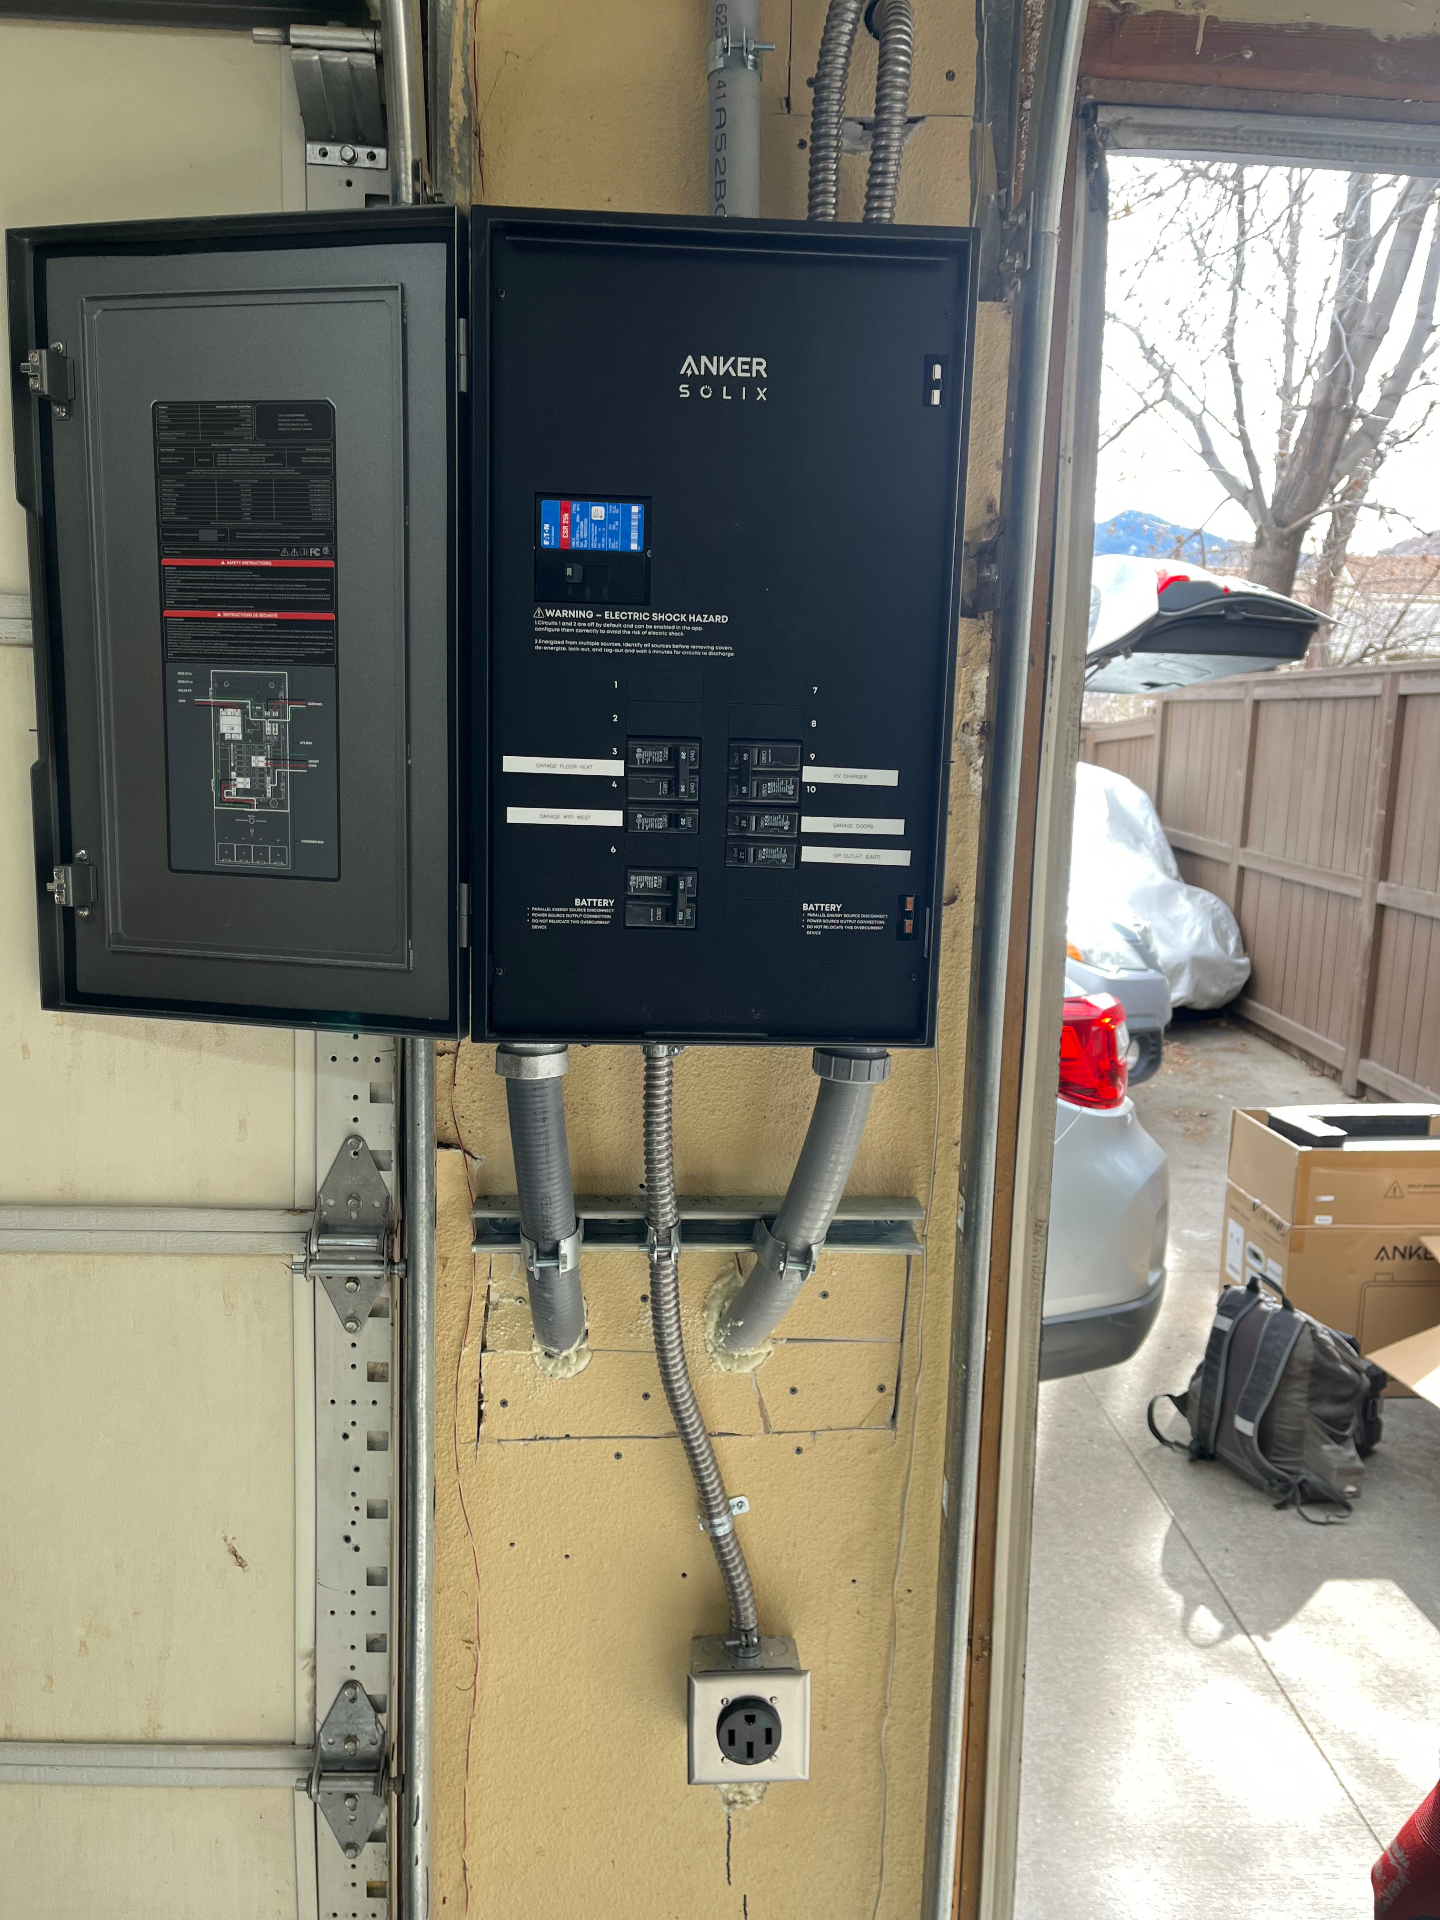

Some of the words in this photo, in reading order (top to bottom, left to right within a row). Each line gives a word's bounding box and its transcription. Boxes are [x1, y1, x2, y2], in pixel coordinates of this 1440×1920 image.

[679, 355, 768, 378] ANKER
[679, 384, 768, 401] SOLIX
[545, 608, 594, 619] WARNING
[604, 611, 650, 621] ELECTRIC
[652, 612, 687, 622] SHOCK
[688, 614, 729, 623] HAZARD
[614, 680, 618, 689] 1
[812, 687, 818, 695] 7
[612, 714, 618, 722] 2
[811, 719, 817, 728] 8
[681, 751, 686, 760] 20
[742, 786, 748, 794] 50
[806, 786, 816, 794] 10
[681, 817, 686, 826] 20
[610, 845, 616, 854] 6
[574, 898, 615, 907] BATTERY
[802, 903, 842, 912] BATTERY
